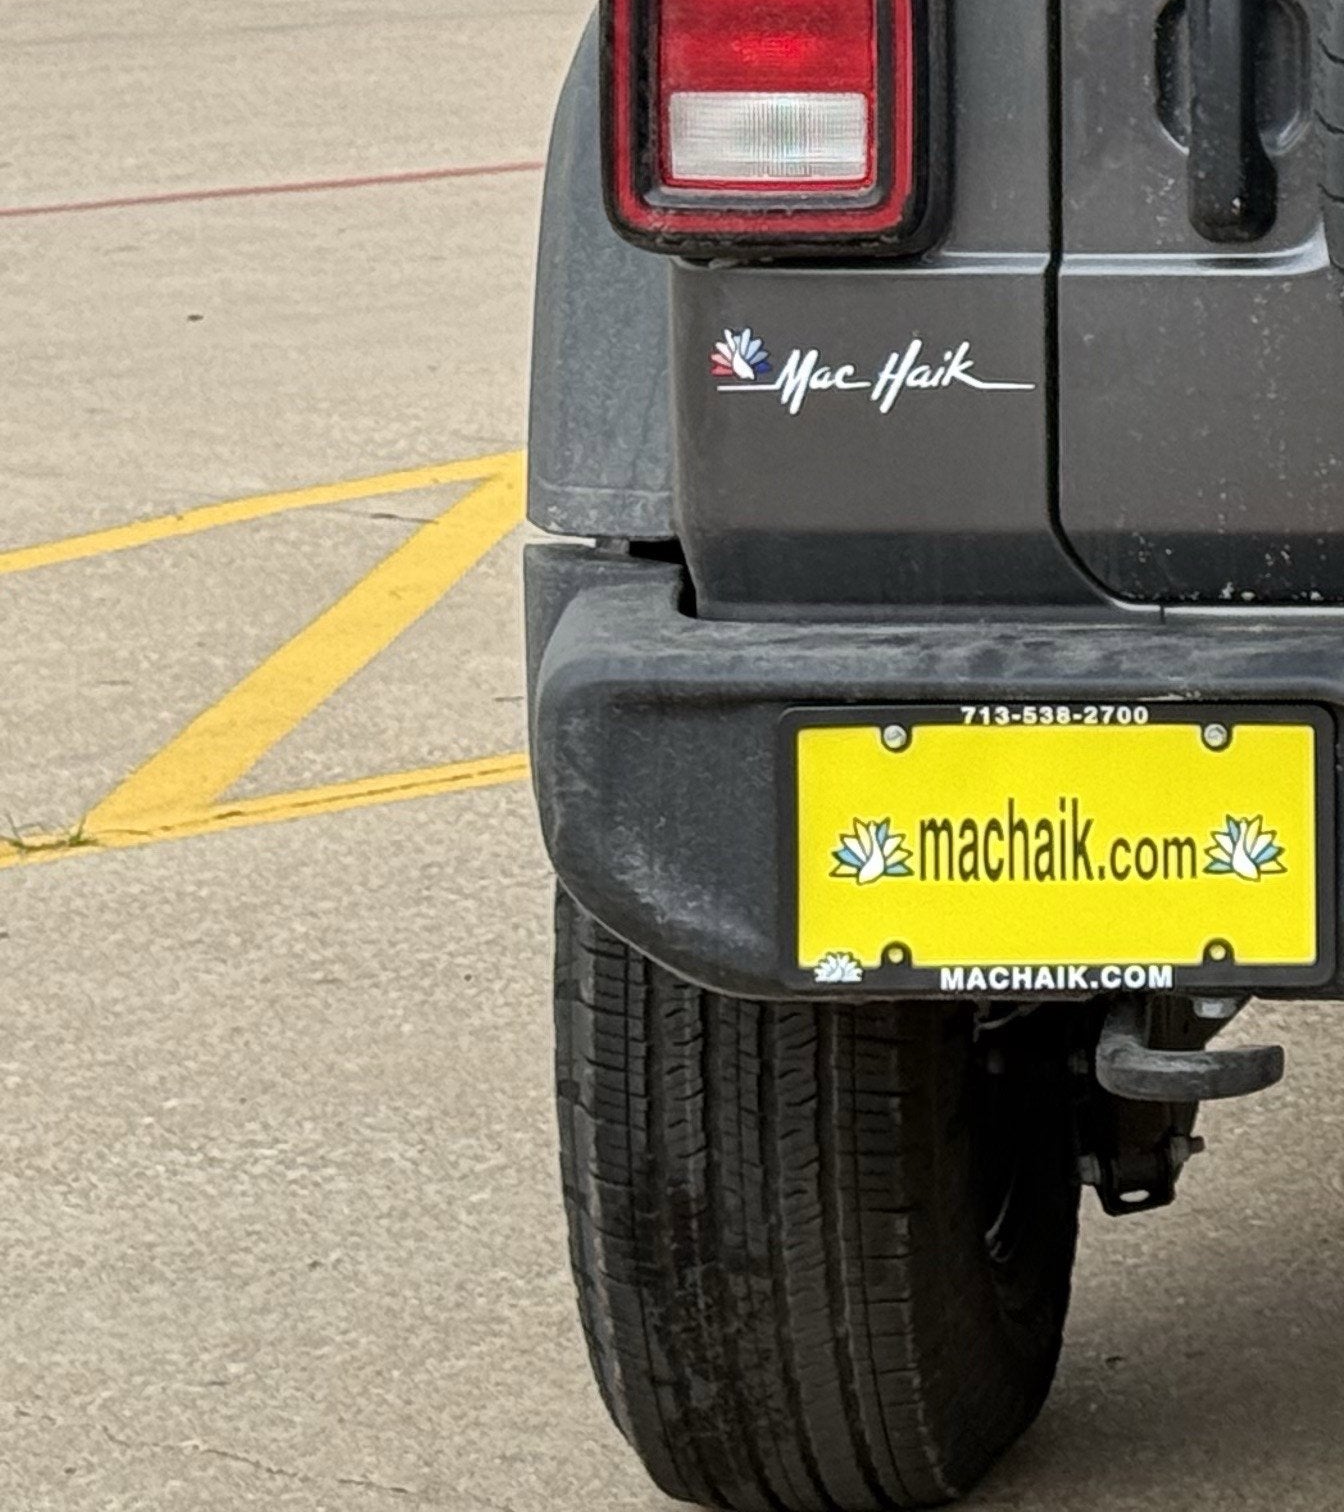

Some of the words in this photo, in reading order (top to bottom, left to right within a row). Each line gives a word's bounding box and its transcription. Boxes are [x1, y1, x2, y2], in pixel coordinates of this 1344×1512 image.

[765, 349, 872, 415] Mac
[870, 338, 1036, 414] Haik
[961, 706, 1149, 725] 713-538-2700
[919, 797, 1198, 882] machaik.com
[940, 966, 1173, 990] MACHAIK.COM
